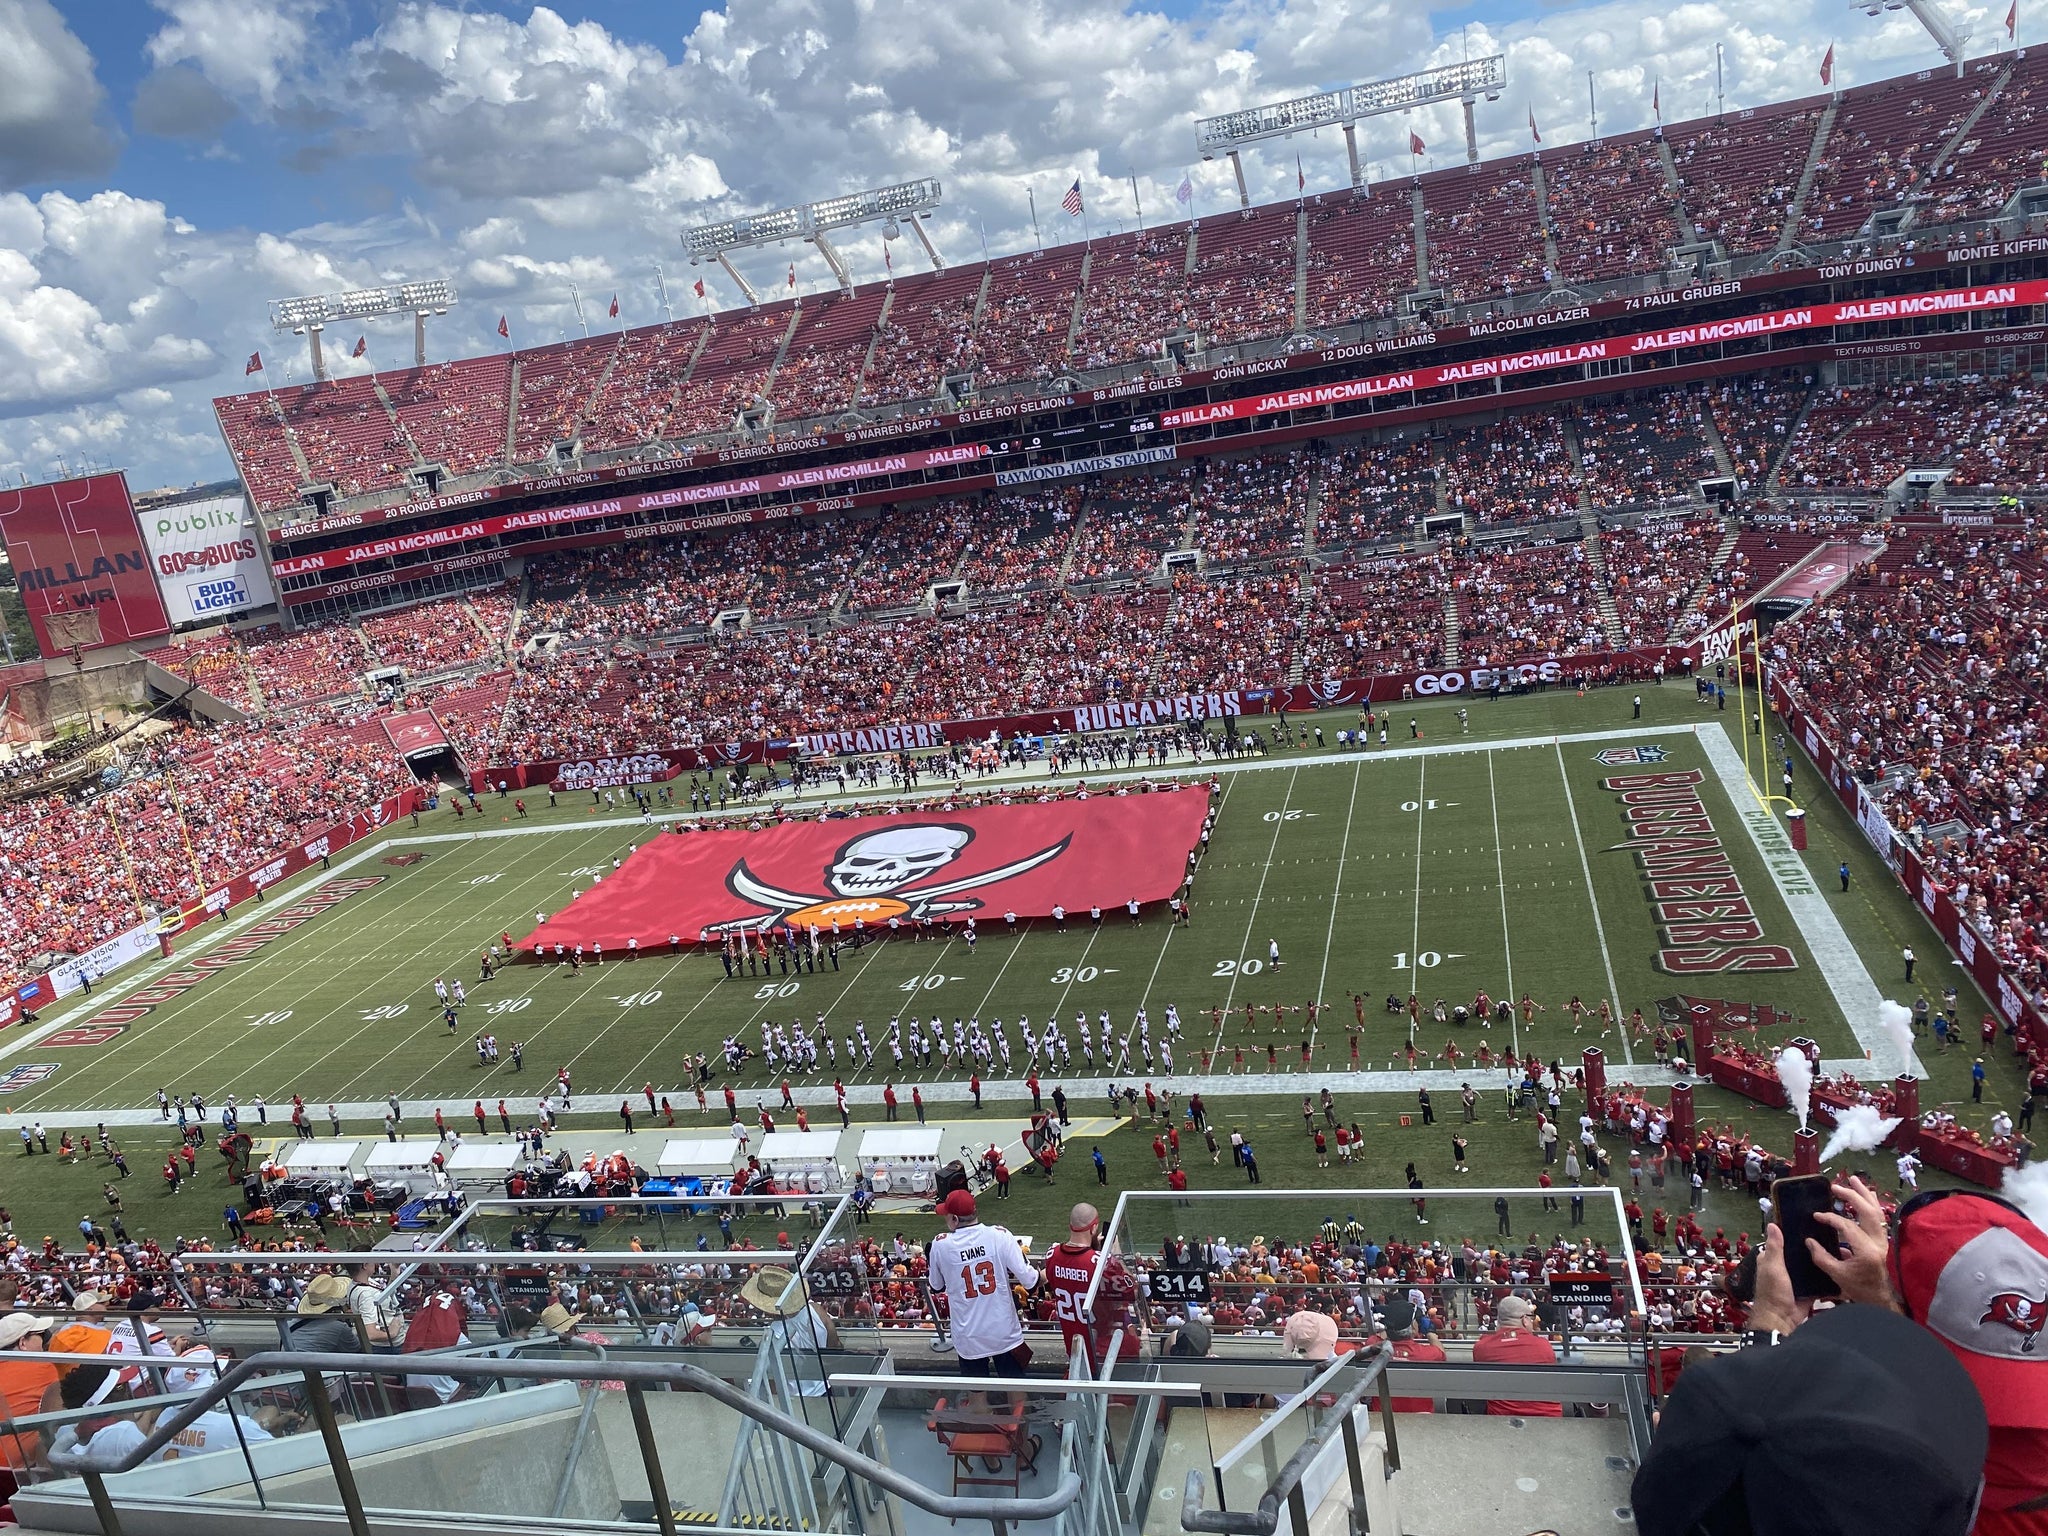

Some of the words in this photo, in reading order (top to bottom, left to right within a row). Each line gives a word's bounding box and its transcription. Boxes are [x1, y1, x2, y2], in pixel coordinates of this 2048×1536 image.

[1947, 244, 2000, 263] MONTE
[1818, 264, 1853, 279] TONY
[1855, 257, 1903, 275] DUNGY
[1624, 299, 1640, 311] 74
[1643, 291, 1679, 307] PAUL
[1682, 281, 1742, 300] GRUBER
[1834, 300, 1897, 321] JALEN
[1900, 288, 2016, 314] MCMILLAN
[1469, 316, 1535, 337] MALCOLM
[1537, 307, 1590, 326] GLAZER
[1631, 329, 1696, 351] JALEN
[1699, 310, 1812, 340] MCMILLAN
[1320, 350, 1334, 362] 12
[1337, 344, 1373, 360] DOUG
[1376, 332, 1436, 352] WILLIAMS
[1835, 346, 1855, 356] TEXT
[1857, 345, 1874, 354] FAN
[1875, 342, 1906, 353] ISSUES
[1909, 341, 1921, 350] TO
[1984, 331, 2045, 344] 813-680-2827
[1213, 366, 1245, 381] JOHN
[1247, 357, 1288, 374] MCKAY
[1437, 361, 1498, 382] JALEN
[1501, 344, 1606, 371] MCMILLAN
[1093, 389, 1106, 401] 88
[1108, 383, 1146, 399] JIMMIE
[1149, 376, 1183, 391] GILES
[1256, 391, 1312, 411] JALEN
[1315, 375, 1414, 402] MCMILLAN
[958, 413, 971, 424] 63
[973, 409, 993, 421] LEE
[996, 404, 1018, 417] ROY
[1020, 396, 1066, 413] SELMON
[845, 431, 856, 442] 99
[858, 424, 903, 440] WARREN
[904, 419, 932, 432] SAPP
[1129, 422, 1155, 433] 5:58
[1163, 416, 1180, 427] 25
[718, 451, 730, 461] 55
[732, 446, 774, 460] DERRICK
[777, 438, 819, 453] BROOKS
[925, 446, 974, 465] JALEN
[615, 467, 626, 477] 40
[628, 463, 651, 476] MIKE
[652, 457, 693, 473] ALSTOTT
[777, 470, 824, 487] JALEN
[826, 457, 907, 480] MCMILLAN
[997, 464, 1067, 486] RAYMOND
[1066, 457, 1112, 476] JAMES
[1113, 445, 1176, 467] STADIUM
[524, 481, 534, 492] 47
[536, 477, 561, 490] JOHN
[562, 473, 592, 486] LYNCH
[638, 492, 682, 508] JALEN
[683, 479, 760, 500] MCMILLAN
[385, 508, 398, 519] 20
[439, 491, 483, 507] BARBER
[502, 513, 548, 530] JALEN
[549, 501, 622, 521] MCMILLAN
[764, 507, 789, 520] 2002
[816, 499, 841, 512] 2020
[281, 523, 319, 538] BRUCE
[322, 514, 362, 530] ARIANS
[624, 525, 658, 539] SUPER
[660, 520, 689, 535] BOWL
[691, 512, 753, 530] CHAMPIONS
[345, 543, 396, 562] JALEN
[399, 524, 484, 550] MCMILLAN
[1534, 538, 1556, 547] 1976
[158, 551, 188, 575] GO
[206, 539, 257, 566] BUCS
[433, 562, 444, 573] 97
[446, 555, 485, 570] SIMEON
[487, 549, 511, 562] RICE
[198, 580, 236, 598] BUD
[327, 583, 349, 596] JON
[350, 573, 395, 590] GRUDEN
[72, 589, 116, 607] WR
[194, 590, 245, 611] LIGHT
[1700, 619, 1755, 649] TAMPA
[1702, 642, 1733, 667] BAY
[1415, 673, 1464, 694] GO
[1073, 691, 1241, 732] BUCCANEERS
[566, 781, 591, 790] BUC
[593, 776, 624, 788] BEAT
[626, 774, 653, 784] LINE
[1605, 768, 1800, 974] BUCCANEERS
[1771, 857, 1814, 897] LOVE
[57, 956, 90, 977] GLAZER
[91, 940, 120, 959] VISION
[1211, 958, 1263, 977] 20
[1391, 951, 1442, 969] 10
[899, 974, 945, 992] 40
[1051, 966, 1099, 984] 30
[618, 990, 663, 1007] 40
[753, 982, 800, 999] 50
[361, 1004, 409, 1021] 20
[486, 997, 533, 1014] 30
[248, 1010, 293, 1026] 10
[960, 1246, 985, 1262] EVANS
[813, 1272, 855, 1288] 313
[961, 1261, 997, 1299] 13
[1055, 1266, 1088, 1282] BARBER
[1156, 1275, 1204, 1292] 314
[1572, 1284, 1590, 1292] NO
[1055, 1288, 1095, 1324] 20
